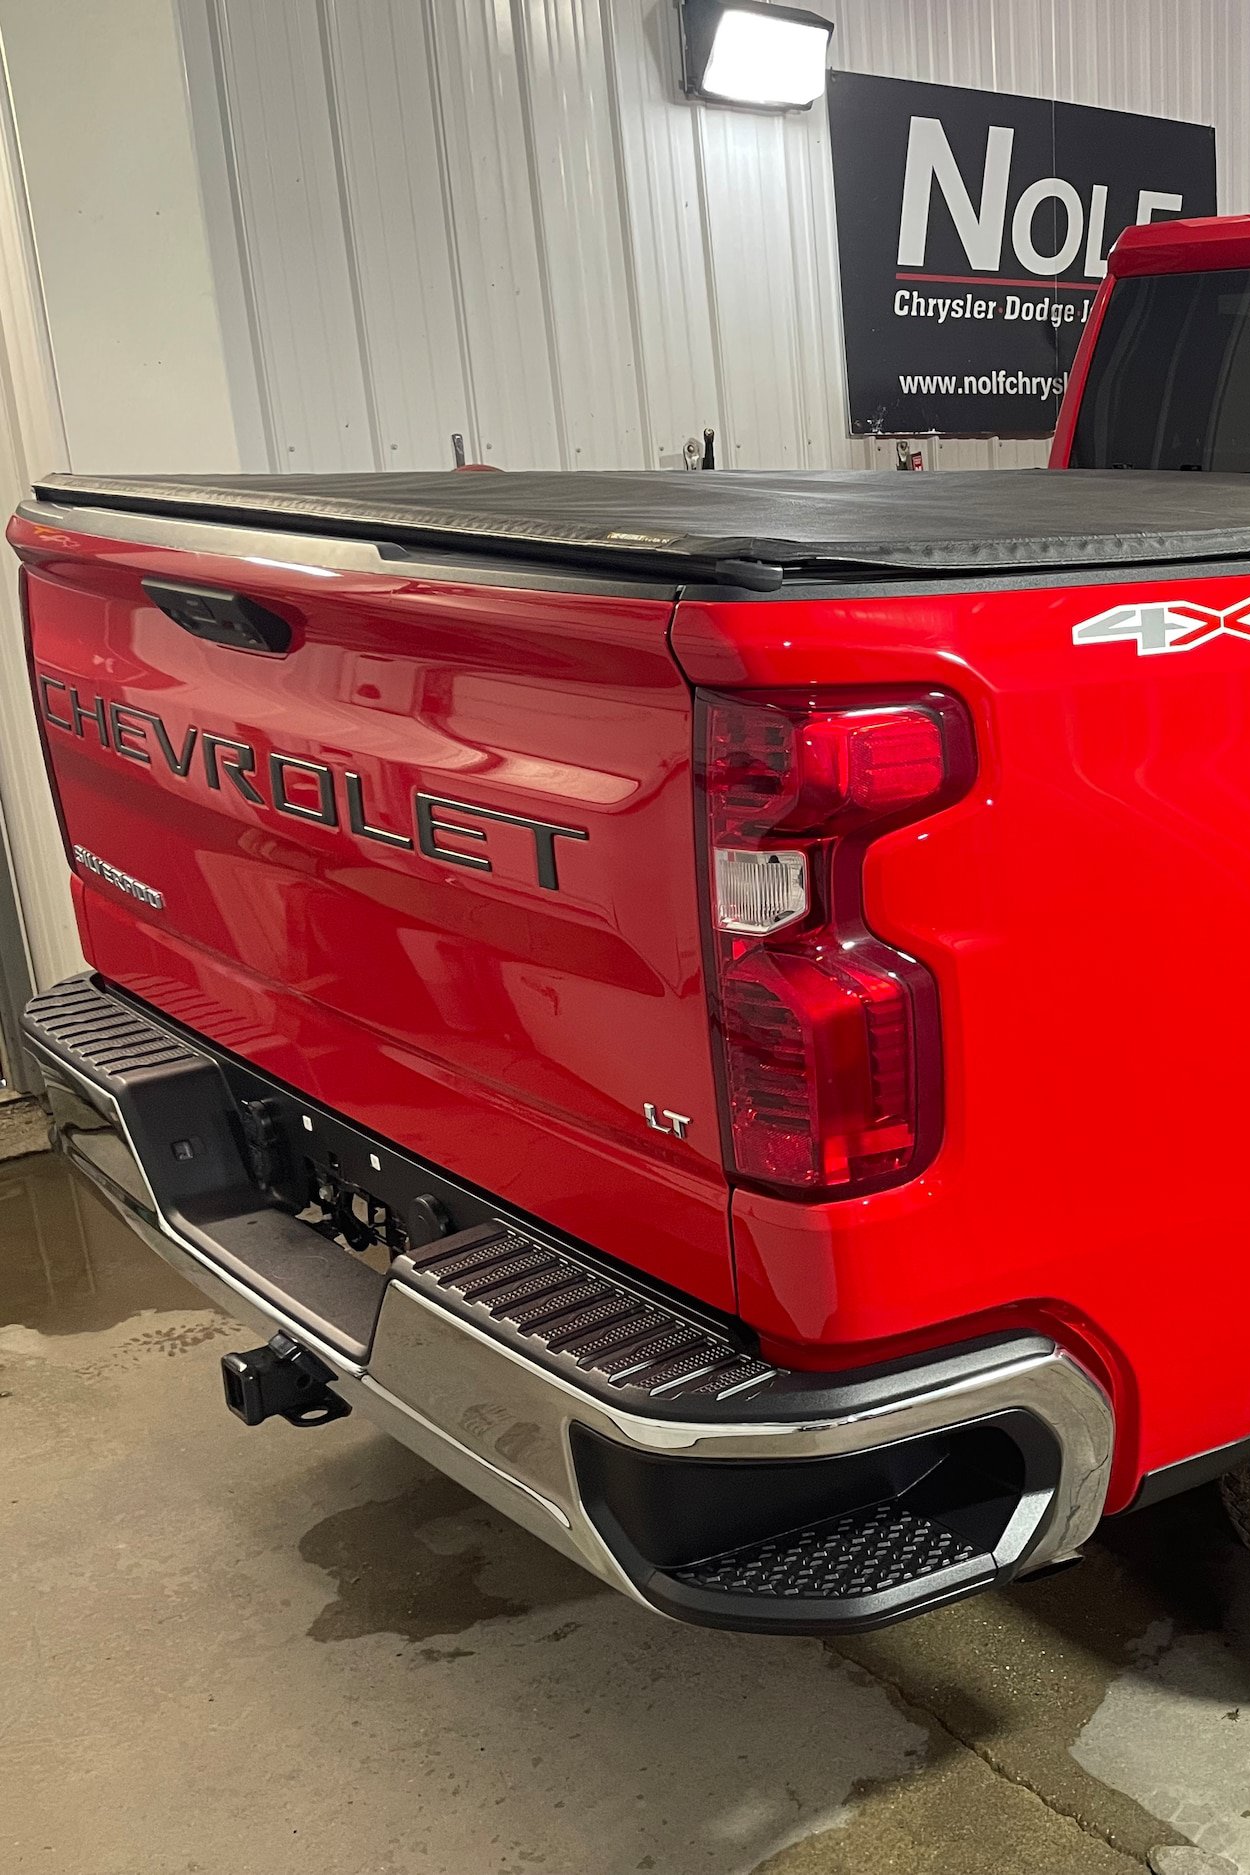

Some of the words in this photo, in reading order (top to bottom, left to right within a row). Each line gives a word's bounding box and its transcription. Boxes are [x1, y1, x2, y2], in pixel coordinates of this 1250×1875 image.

[893, 289, 997, 324] Chrysler
[1004, 295, 1075, 328] Dodge
[38, 672, 589, 891] CHEVROLET
[73, 844, 165, 910] SILVERADO
[643, 1102, 693, 1139] LT
